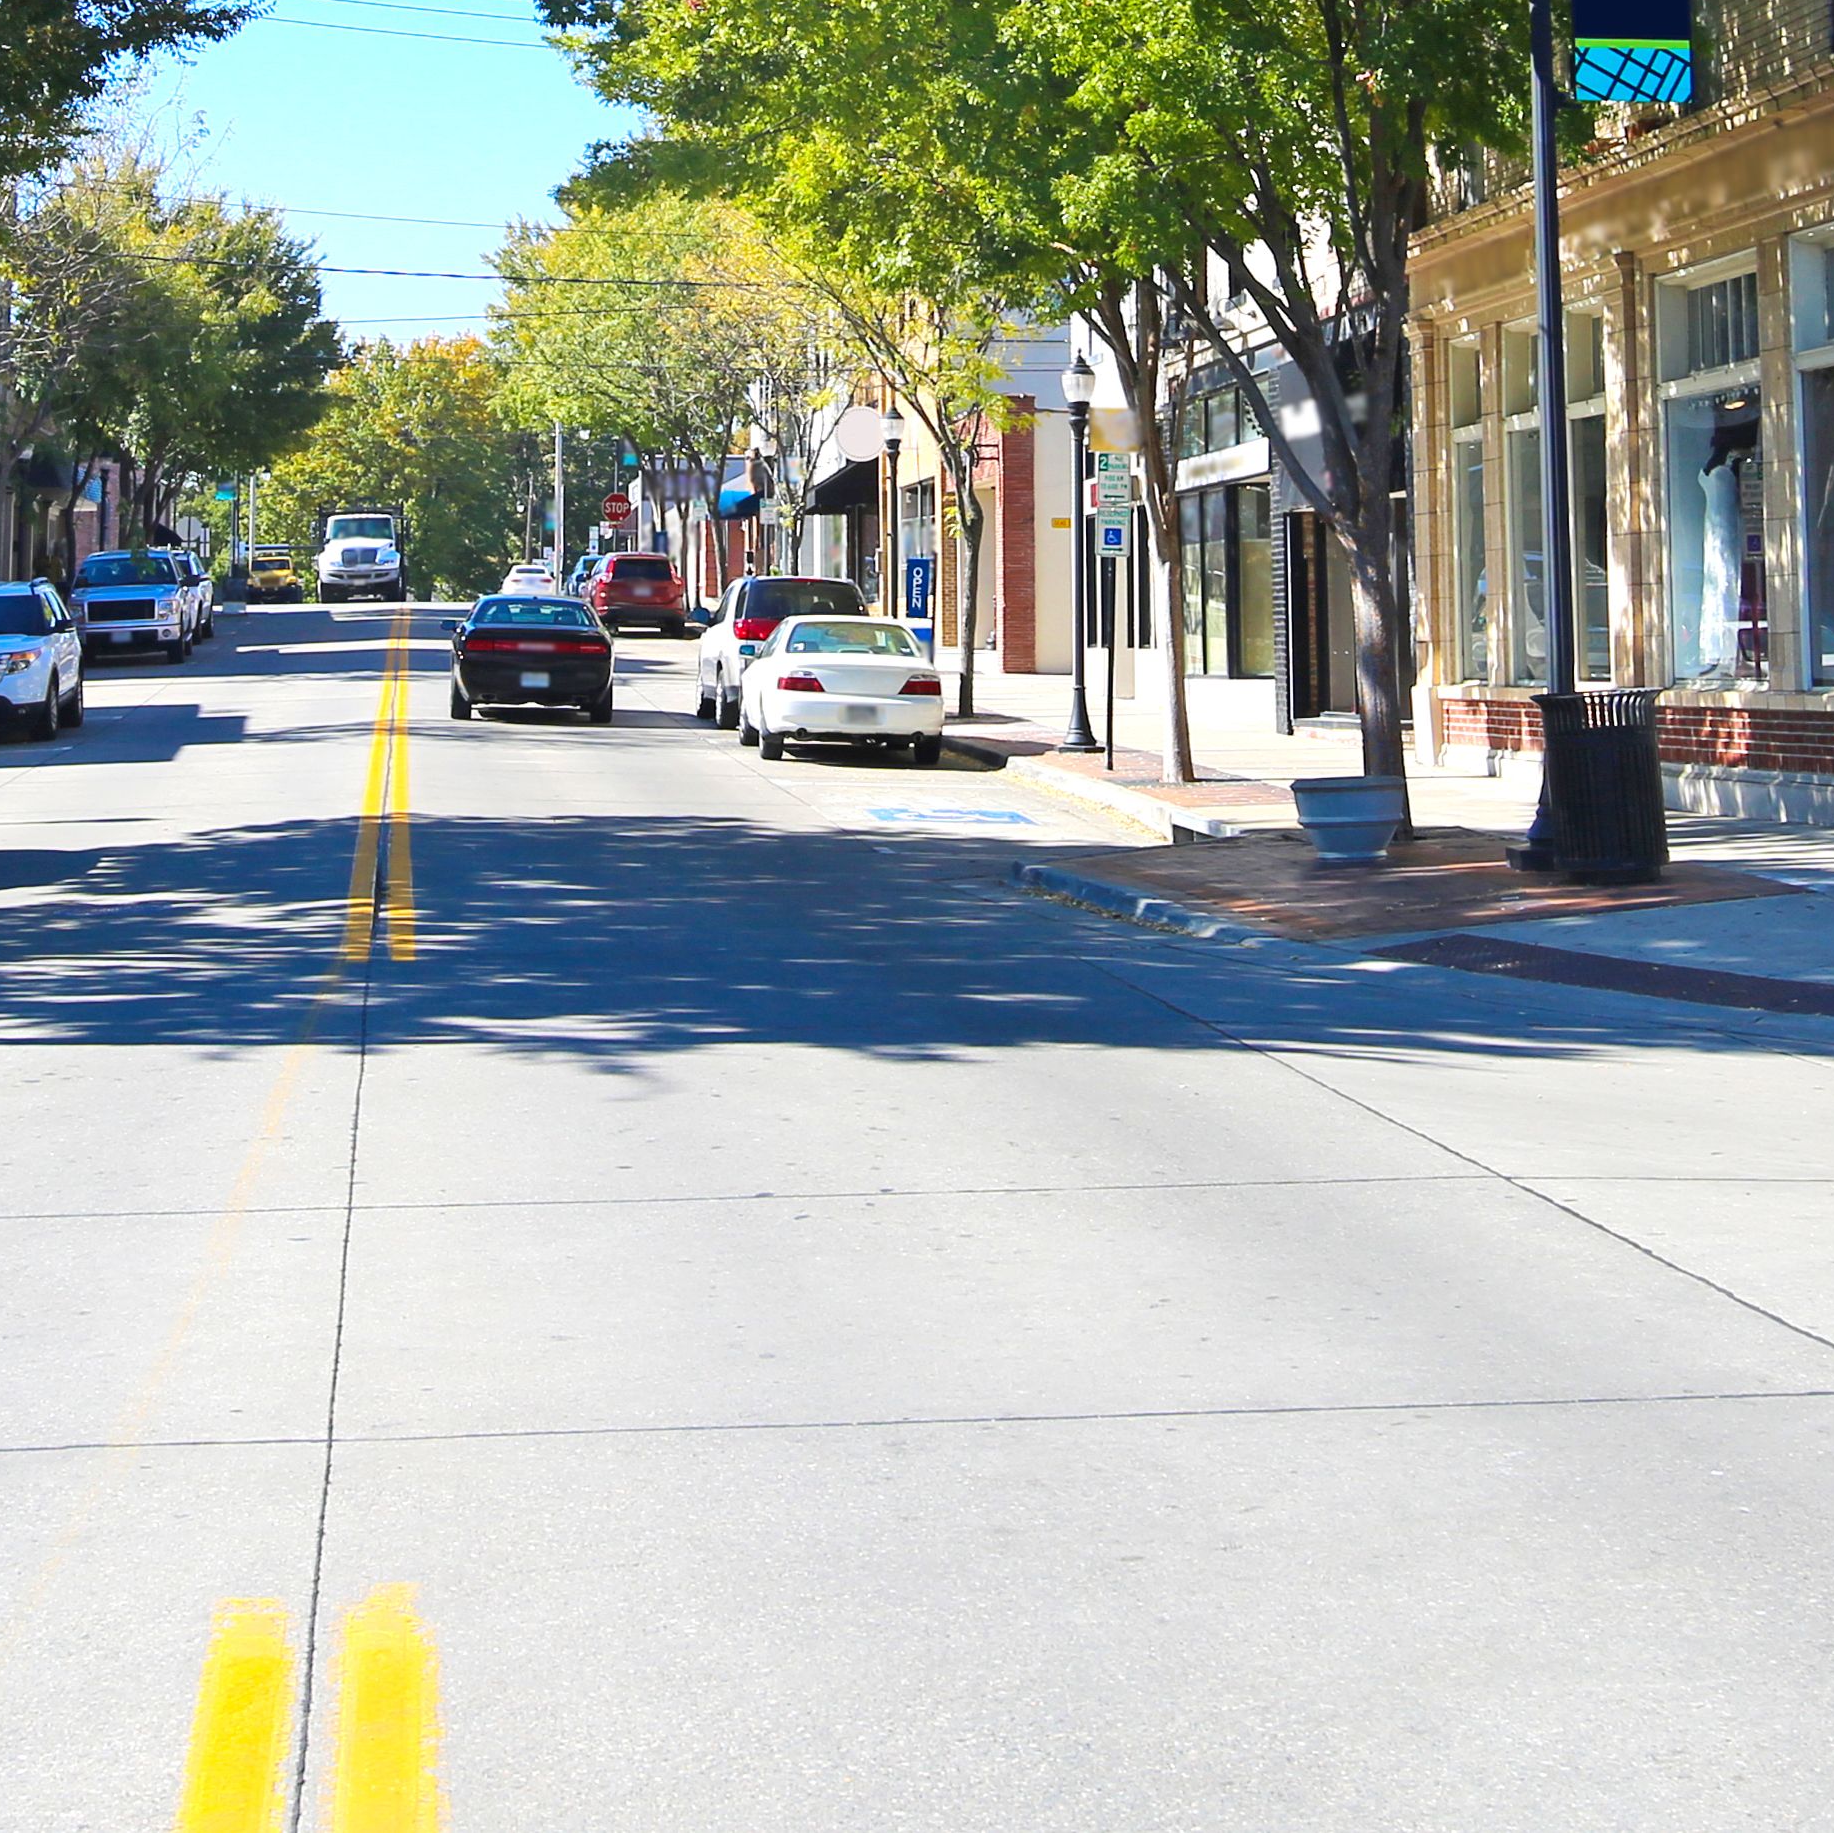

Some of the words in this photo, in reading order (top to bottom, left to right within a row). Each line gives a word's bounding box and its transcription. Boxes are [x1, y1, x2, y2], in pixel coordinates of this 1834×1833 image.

[1099, 455, 1108, 471] 2
[604, 501, 630, 514] STOP
[912, 566, 924, 610] OPEN
